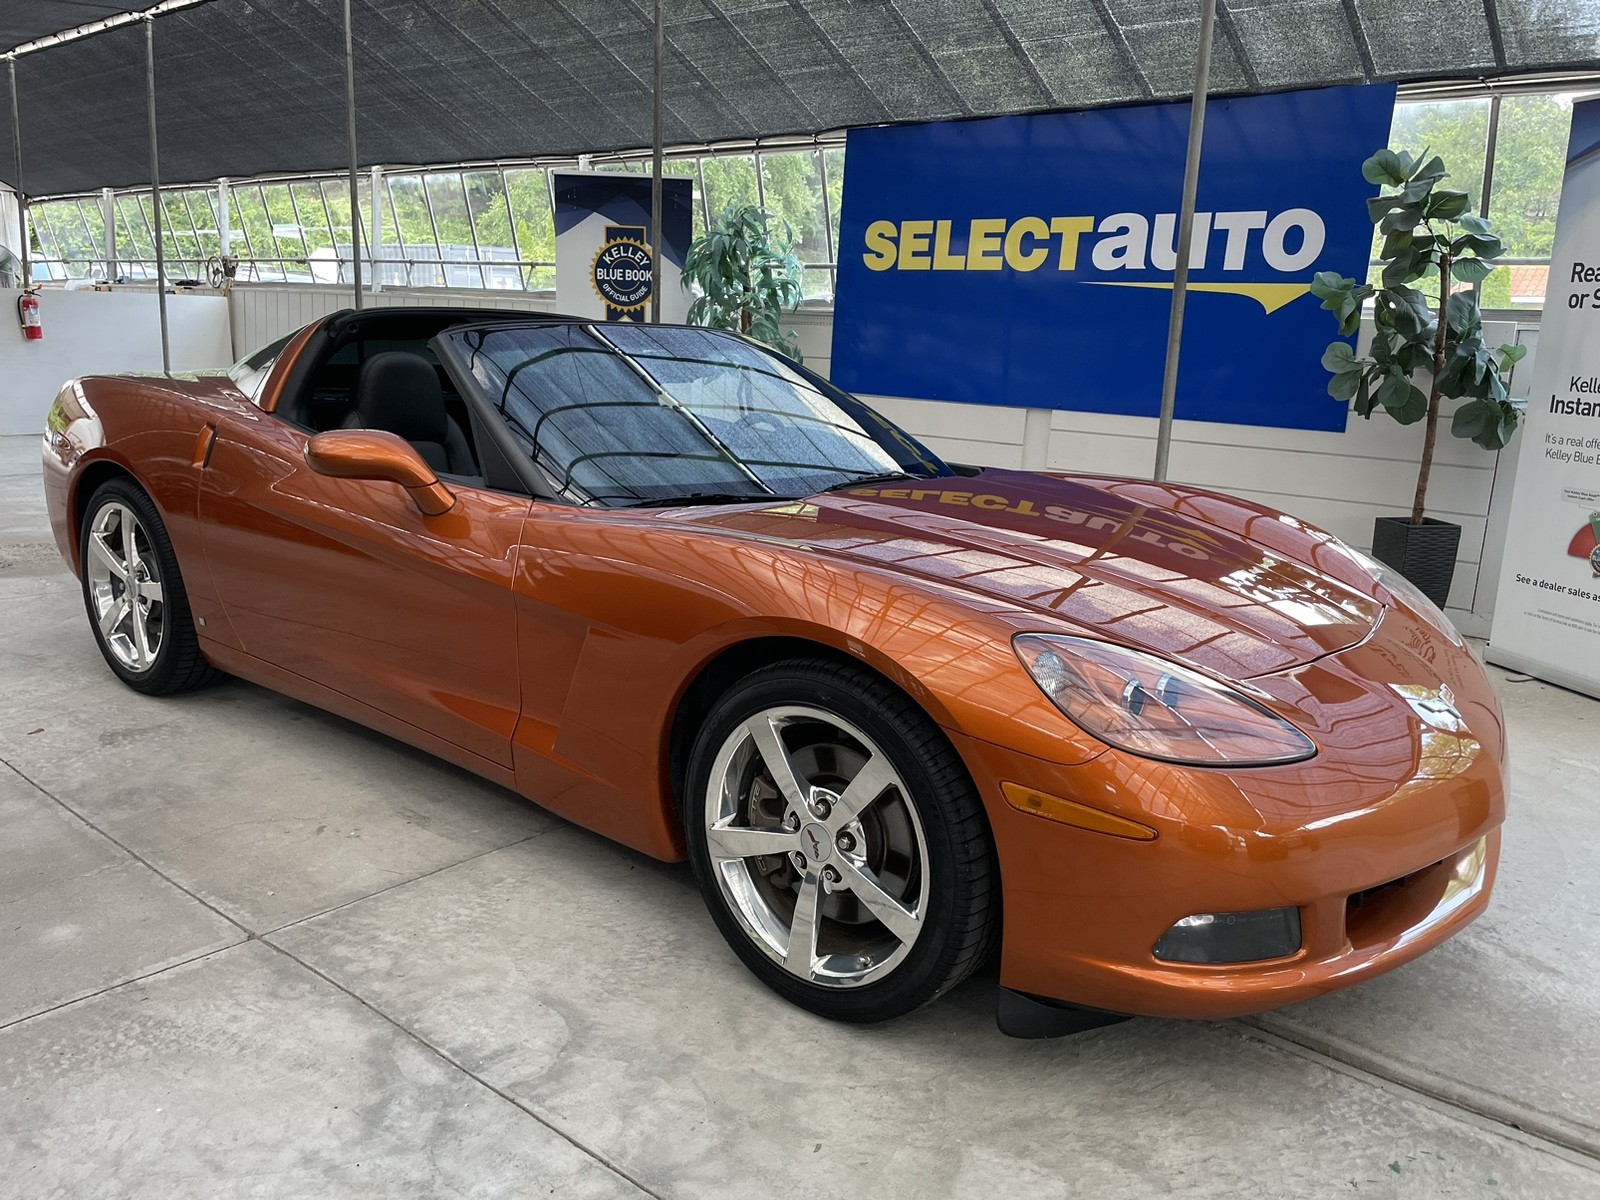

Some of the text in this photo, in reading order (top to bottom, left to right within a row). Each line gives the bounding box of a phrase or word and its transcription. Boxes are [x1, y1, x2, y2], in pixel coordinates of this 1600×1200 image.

[602, 245, 650, 266] KELLEY
[596, 268, 653, 282] BLUE BOOK
[602, 283, 648, 302] OFFICIAL GUIDE
[1568, 293, 1590, 309] or
[1549, 394, 1600, 418] Instan
[1558, 437, 1564, 446] a
[1566, 436, 1584, 447] real
[1544, 448, 1572, 464] Kelley
[1573, 451, 1594, 464] Blue
[1515, 573, 1531, 585] See
[1539, 580, 1567, 593] dealer
[1567, 588, 1591, 599] sales
